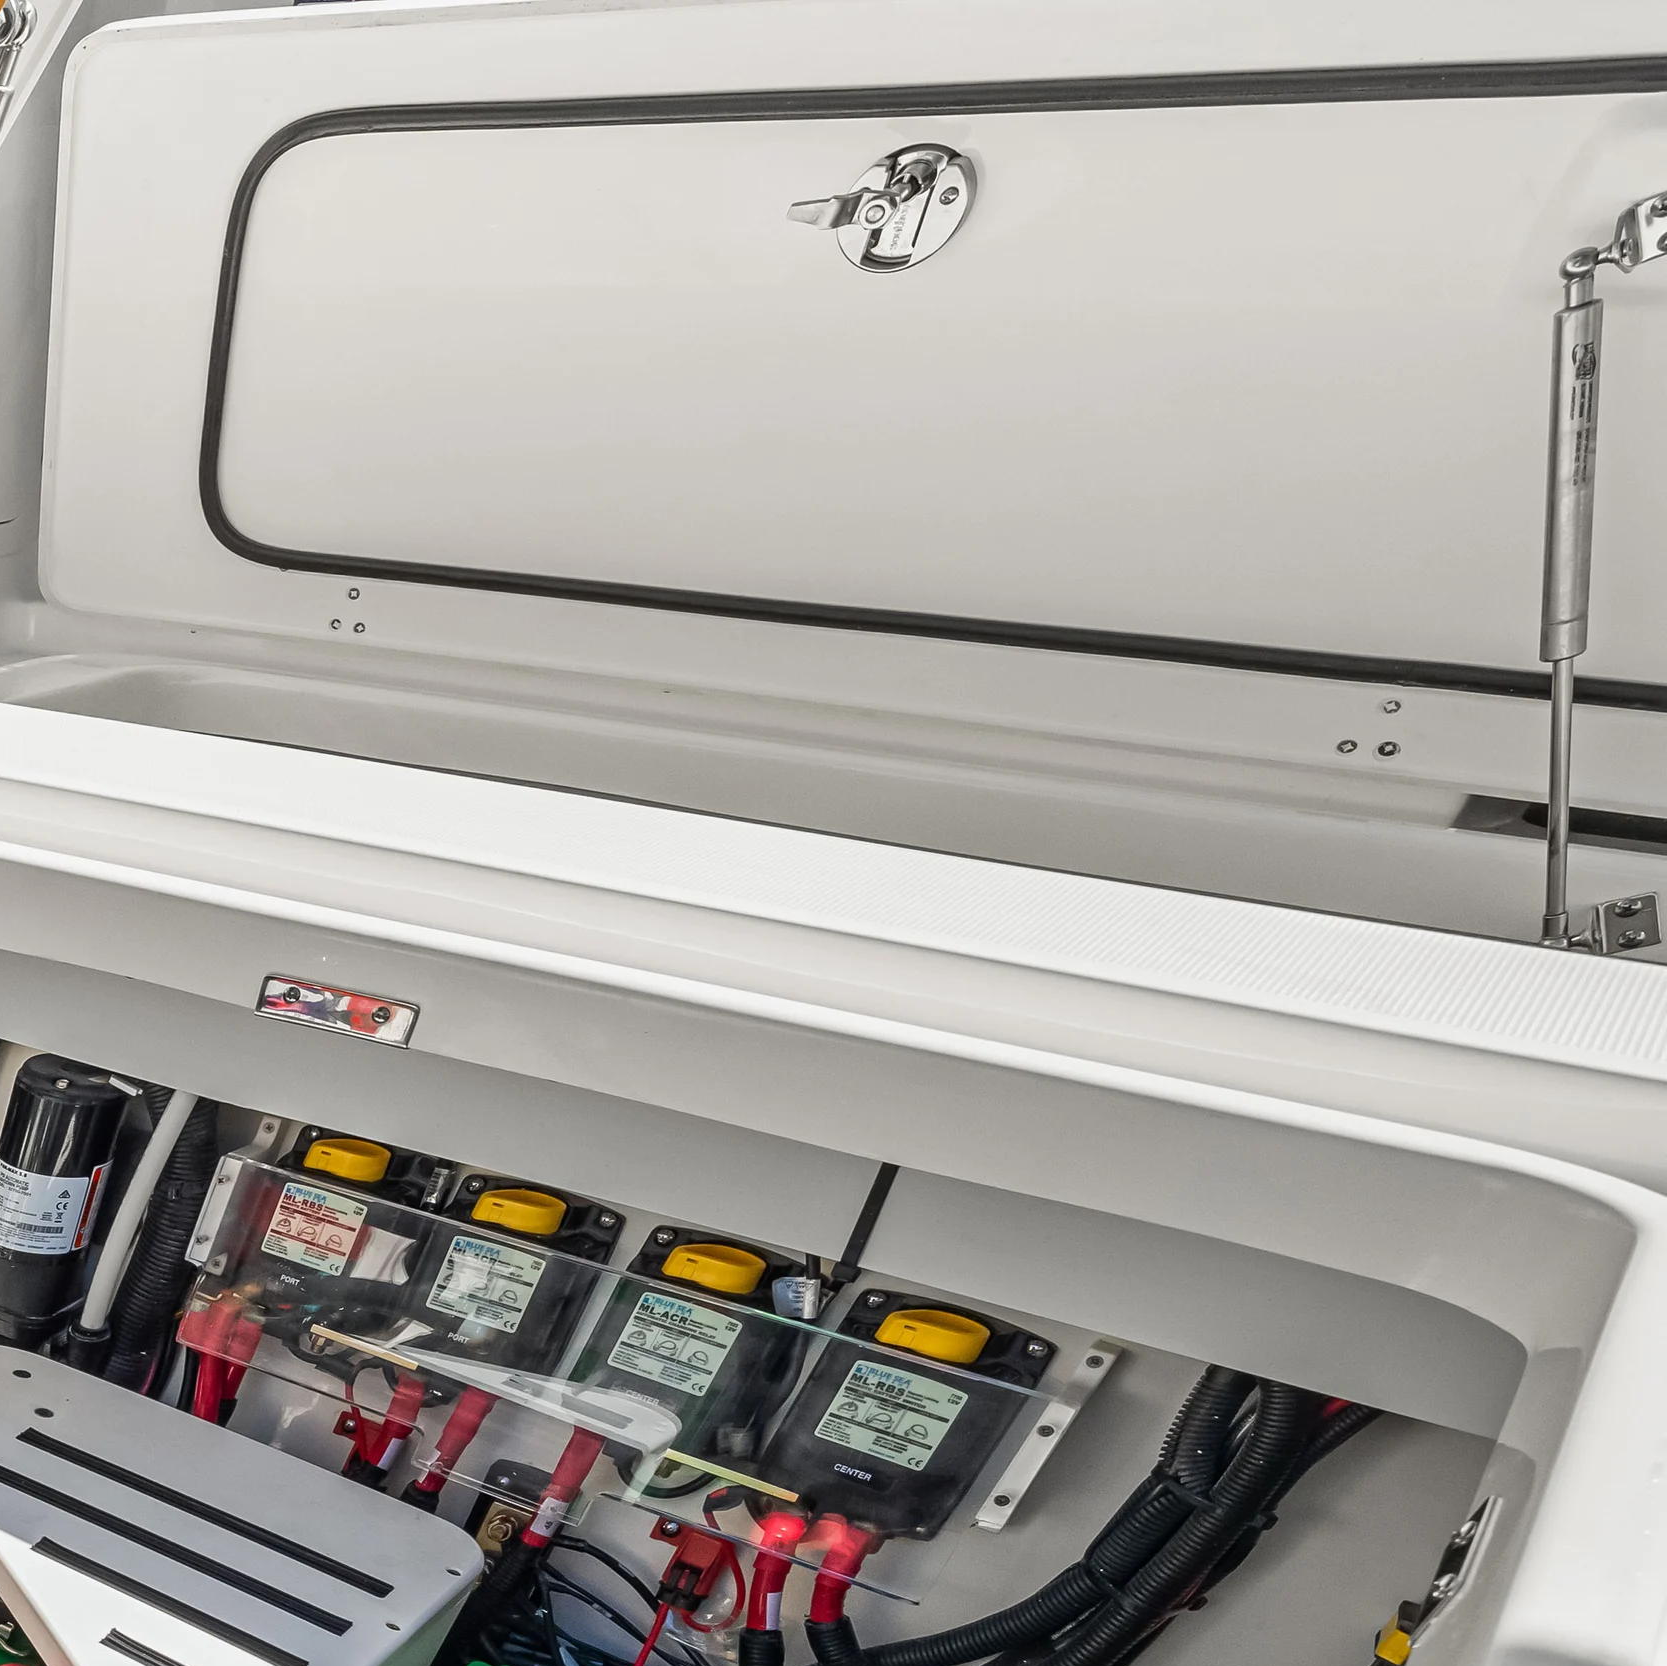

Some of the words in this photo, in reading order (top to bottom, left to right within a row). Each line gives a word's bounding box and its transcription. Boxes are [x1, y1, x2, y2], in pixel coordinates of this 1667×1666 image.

[56, 1202, 68, 1210] CE
[282, 1191, 324, 1212] ML-RBS
[328, 1262, 340, 1273] CE
[280, 1275, 300, 1286] PORT
[653, 1296, 676, 1310] BLUE
[676, 1304, 694, 1315] SEA
[637, 1302, 689, 1325] ML-ACR
[503, 1320, 516, 1330] CE
[724, 1325, 736, 1333] 12V
[447, 1332, 470, 1344] PORT
[867, 1366, 893, 1380] BLUE
[893, 1374, 912, 1387] SEA
[690, 1382, 705, 1393] CE
[850, 1372, 906, 1398] ML-RBS
[947, 1398, 960, 1406] 12V
[906, 1456, 923, 1468] CE
[833, 1462, 872, 1483] CENTER
